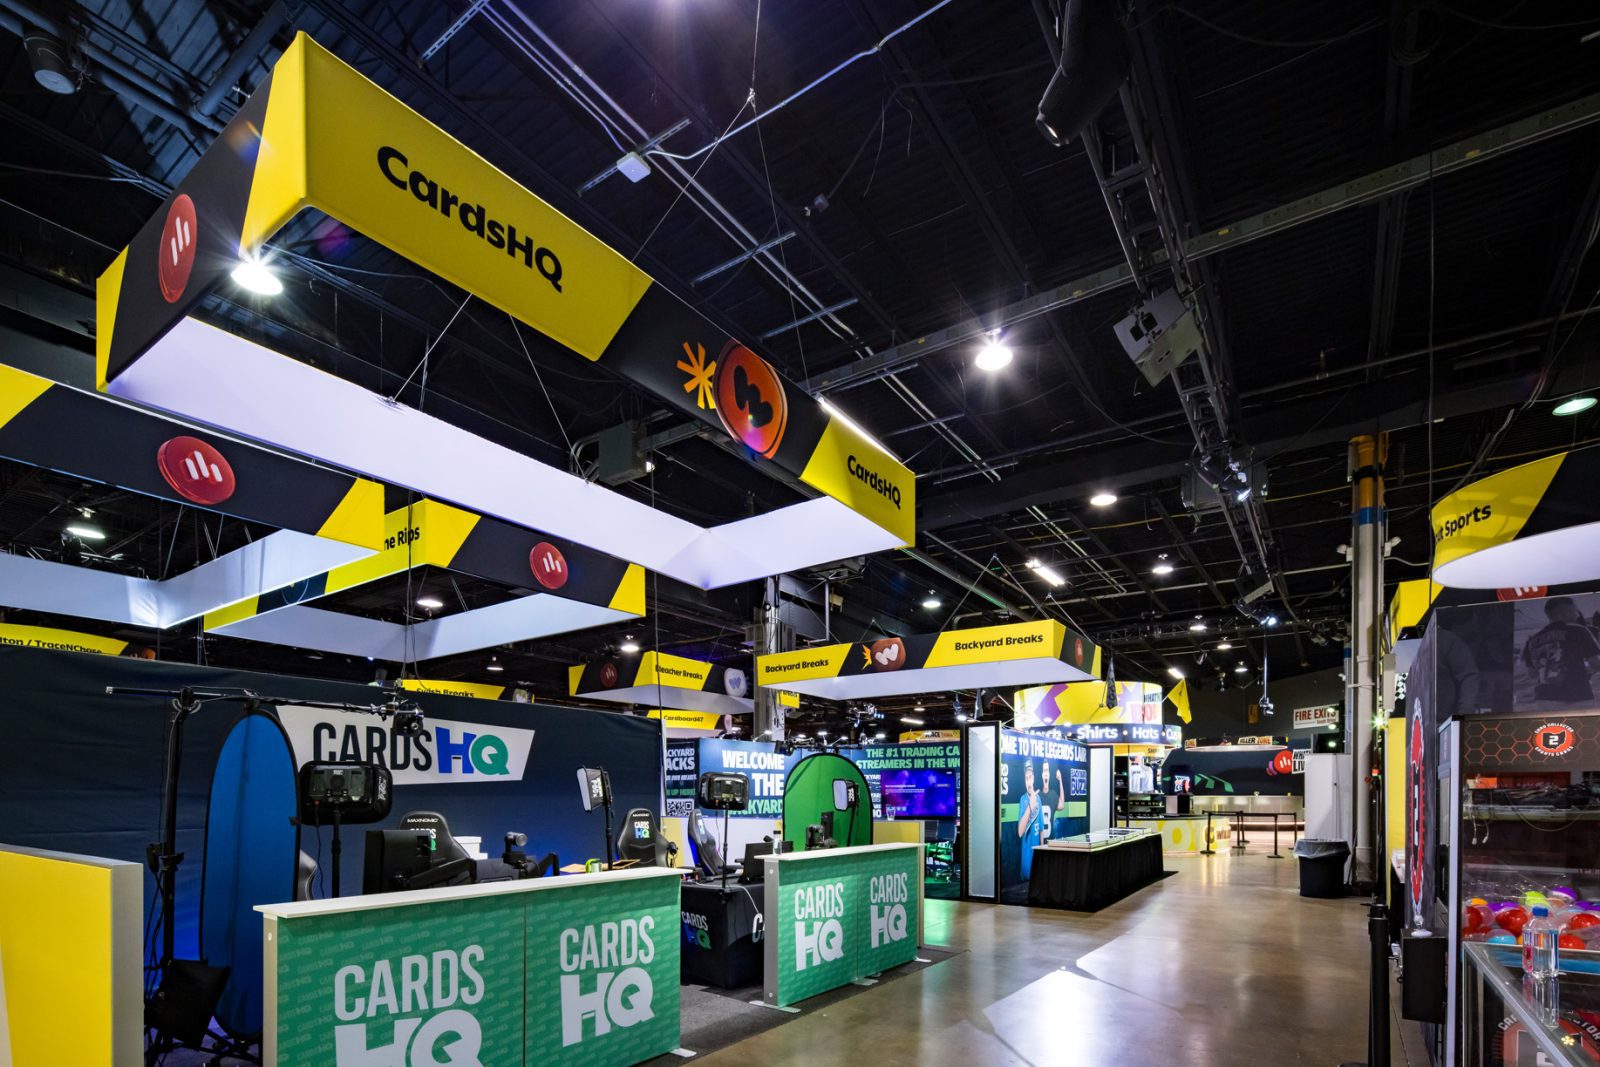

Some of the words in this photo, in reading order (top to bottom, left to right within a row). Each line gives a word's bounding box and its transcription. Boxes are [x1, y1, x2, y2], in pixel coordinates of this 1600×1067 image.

[377, 145, 563, 294] CardsHQ
[847, 455, 901, 510] CardsHQ
[1445, 505, 1492, 537] Sports
[397, 526, 420, 546] Rips
[955, 638, 1003, 651] Backyard
[1005, 634, 1044, 646] Breaks
[655, 664, 682, 677] Bleacher
[682, 669, 703, 680] Breaks
[765, 662, 800, 673] Backyard
[802, 659, 829, 669] Breaks
[664, 714, 704, 723] Cardboard47
[1295, 710, 1312, 721] FIRE
[1314, 708, 1337, 719] EXITS
[1076, 725, 1118, 740] Shirts
[1132, 726, 1159, 739] Hats
[1548, 735, 1559, 746] 2
[722, 749, 784, 770] WELCOME
[866, 748, 884, 758] THE
[886, 747, 899, 758] #1
[900, 746, 944, 758] TRADING
[946, 746, 960, 757] CA
[1018, 736, 1029, 756] TO
[1030, 738, 1045, 758] THE
[1045, 740, 1074, 761] LEGENDS
[856, 759, 912, 769] STREAMERS
[914, 758, 925, 769] IN
[927, 758, 946, 769] THE
[751, 772, 784, 797] THE
[635, 829, 650, 839] HQ
[870, 872, 908, 904] CARDS
[795, 882, 844, 920] CARDS
[681, 910, 708, 931] CARDS
[870, 903, 908, 949] HQ
[560, 915, 655, 972] CARDS
[795, 918, 844, 972] HQ
[334, 944, 485, 1021] CARDS
[560, 966, 655, 1048] HQ
[334, 1009, 485, 1067] HQ
